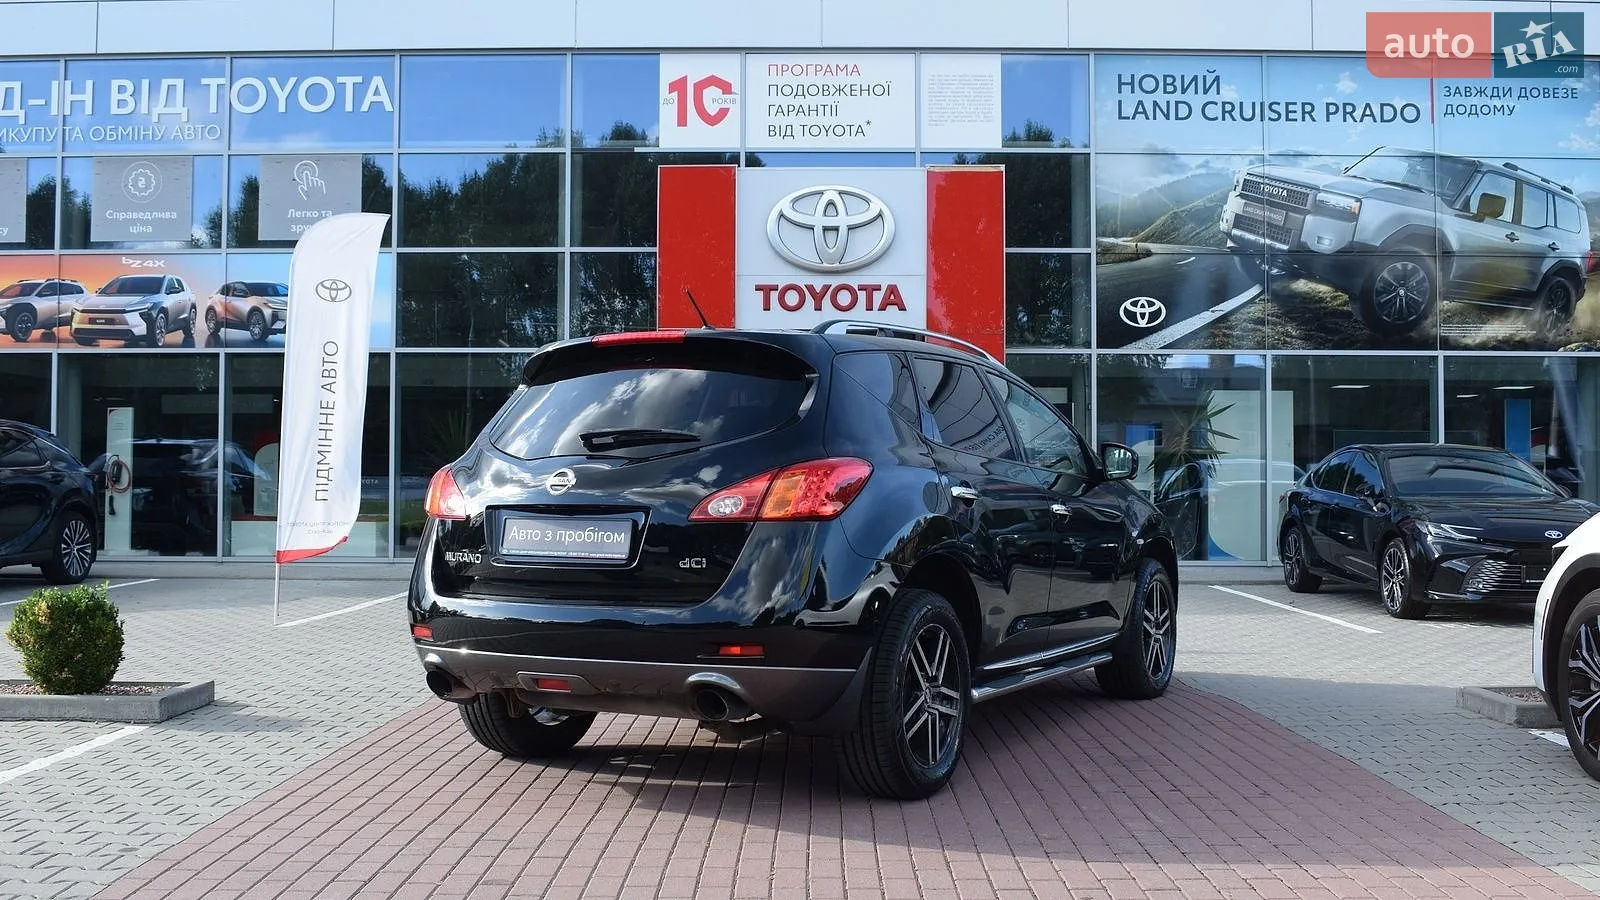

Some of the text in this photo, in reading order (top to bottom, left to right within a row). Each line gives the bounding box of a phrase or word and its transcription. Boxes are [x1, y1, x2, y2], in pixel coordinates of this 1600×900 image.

[767, 63, 861, 77] ПРОГРАМА
[767, 80, 892, 99] ПОДОВЖЕНОЇ
[1117, 69, 1221, 95] НОВИЙ
[110, 78, 189, 123] ВІД
[200, 76, 394, 114] TOYOTA
[711, 97, 737, 105] РОКІВ
[1443, 86, 1579, 101] ЗАВЖДИ ДОВЕЗЕ
[767, 101, 839, 118] ГАРАНТІЇ
[1117, 100, 1422, 124] LAND CRUISER PRADO
[1443, 104, 1516, 118] ДОДОМУ
[63, 126, 84, 142] ТА
[89, 125, 166, 142] ОБМІНУ
[171, 124, 221, 140] АВТО
[767, 124, 795, 140] ВІД
[1260, 184, 1288, 197] TOYOTA
[105, 210, 177, 221] Справедлива
[288, 208, 333, 219] Легко та
[129, 223, 153, 234] ціна
[755, 284, 907, 312] TOYOTA
[315, 340, 339, 502] ПІДМІННЕ АВТО
[508, 525, 626, 546] Авто з пробігом
[444, 551, 482, 564] MURANO
[679, 557, 707, 569] dCi
